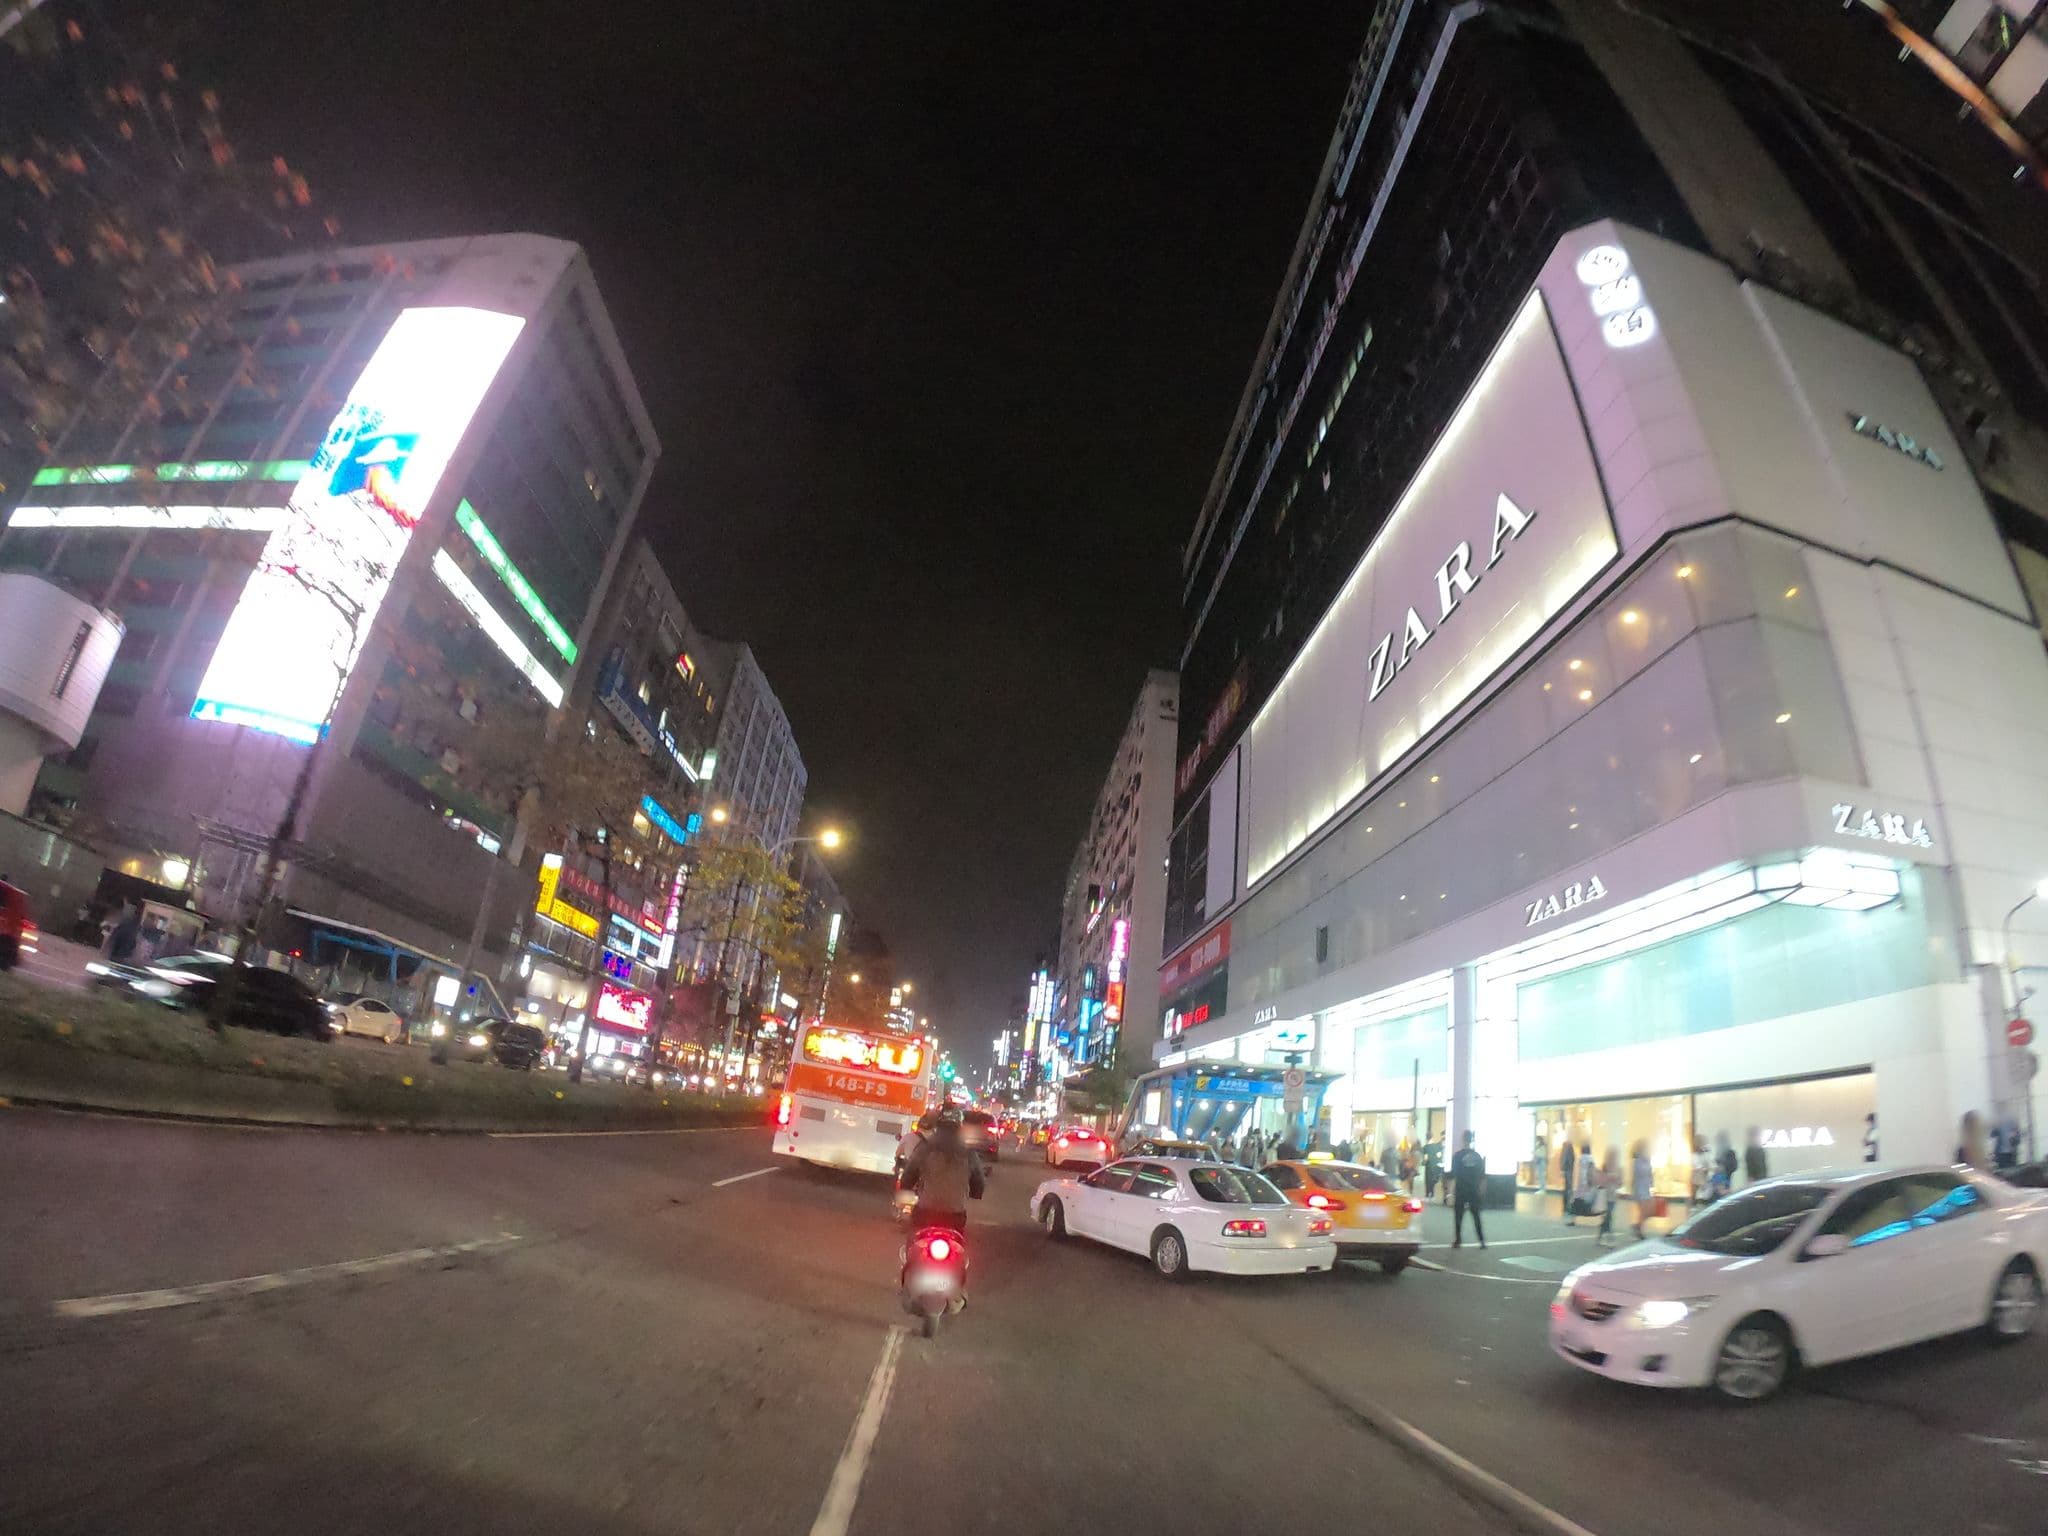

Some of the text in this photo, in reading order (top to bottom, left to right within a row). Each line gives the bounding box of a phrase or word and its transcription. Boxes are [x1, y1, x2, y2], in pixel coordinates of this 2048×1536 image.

[1367, 491, 1538, 703] ZARA
[1831, 802, 1934, 848] ZARA
[1525, 875, 1609, 928] ZARA
[1253, 1005, 1278, 1025] ZARA
[825, 1073, 888, 1098] 148-FS
[1760, 1126, 1836, 1148] ZARA
